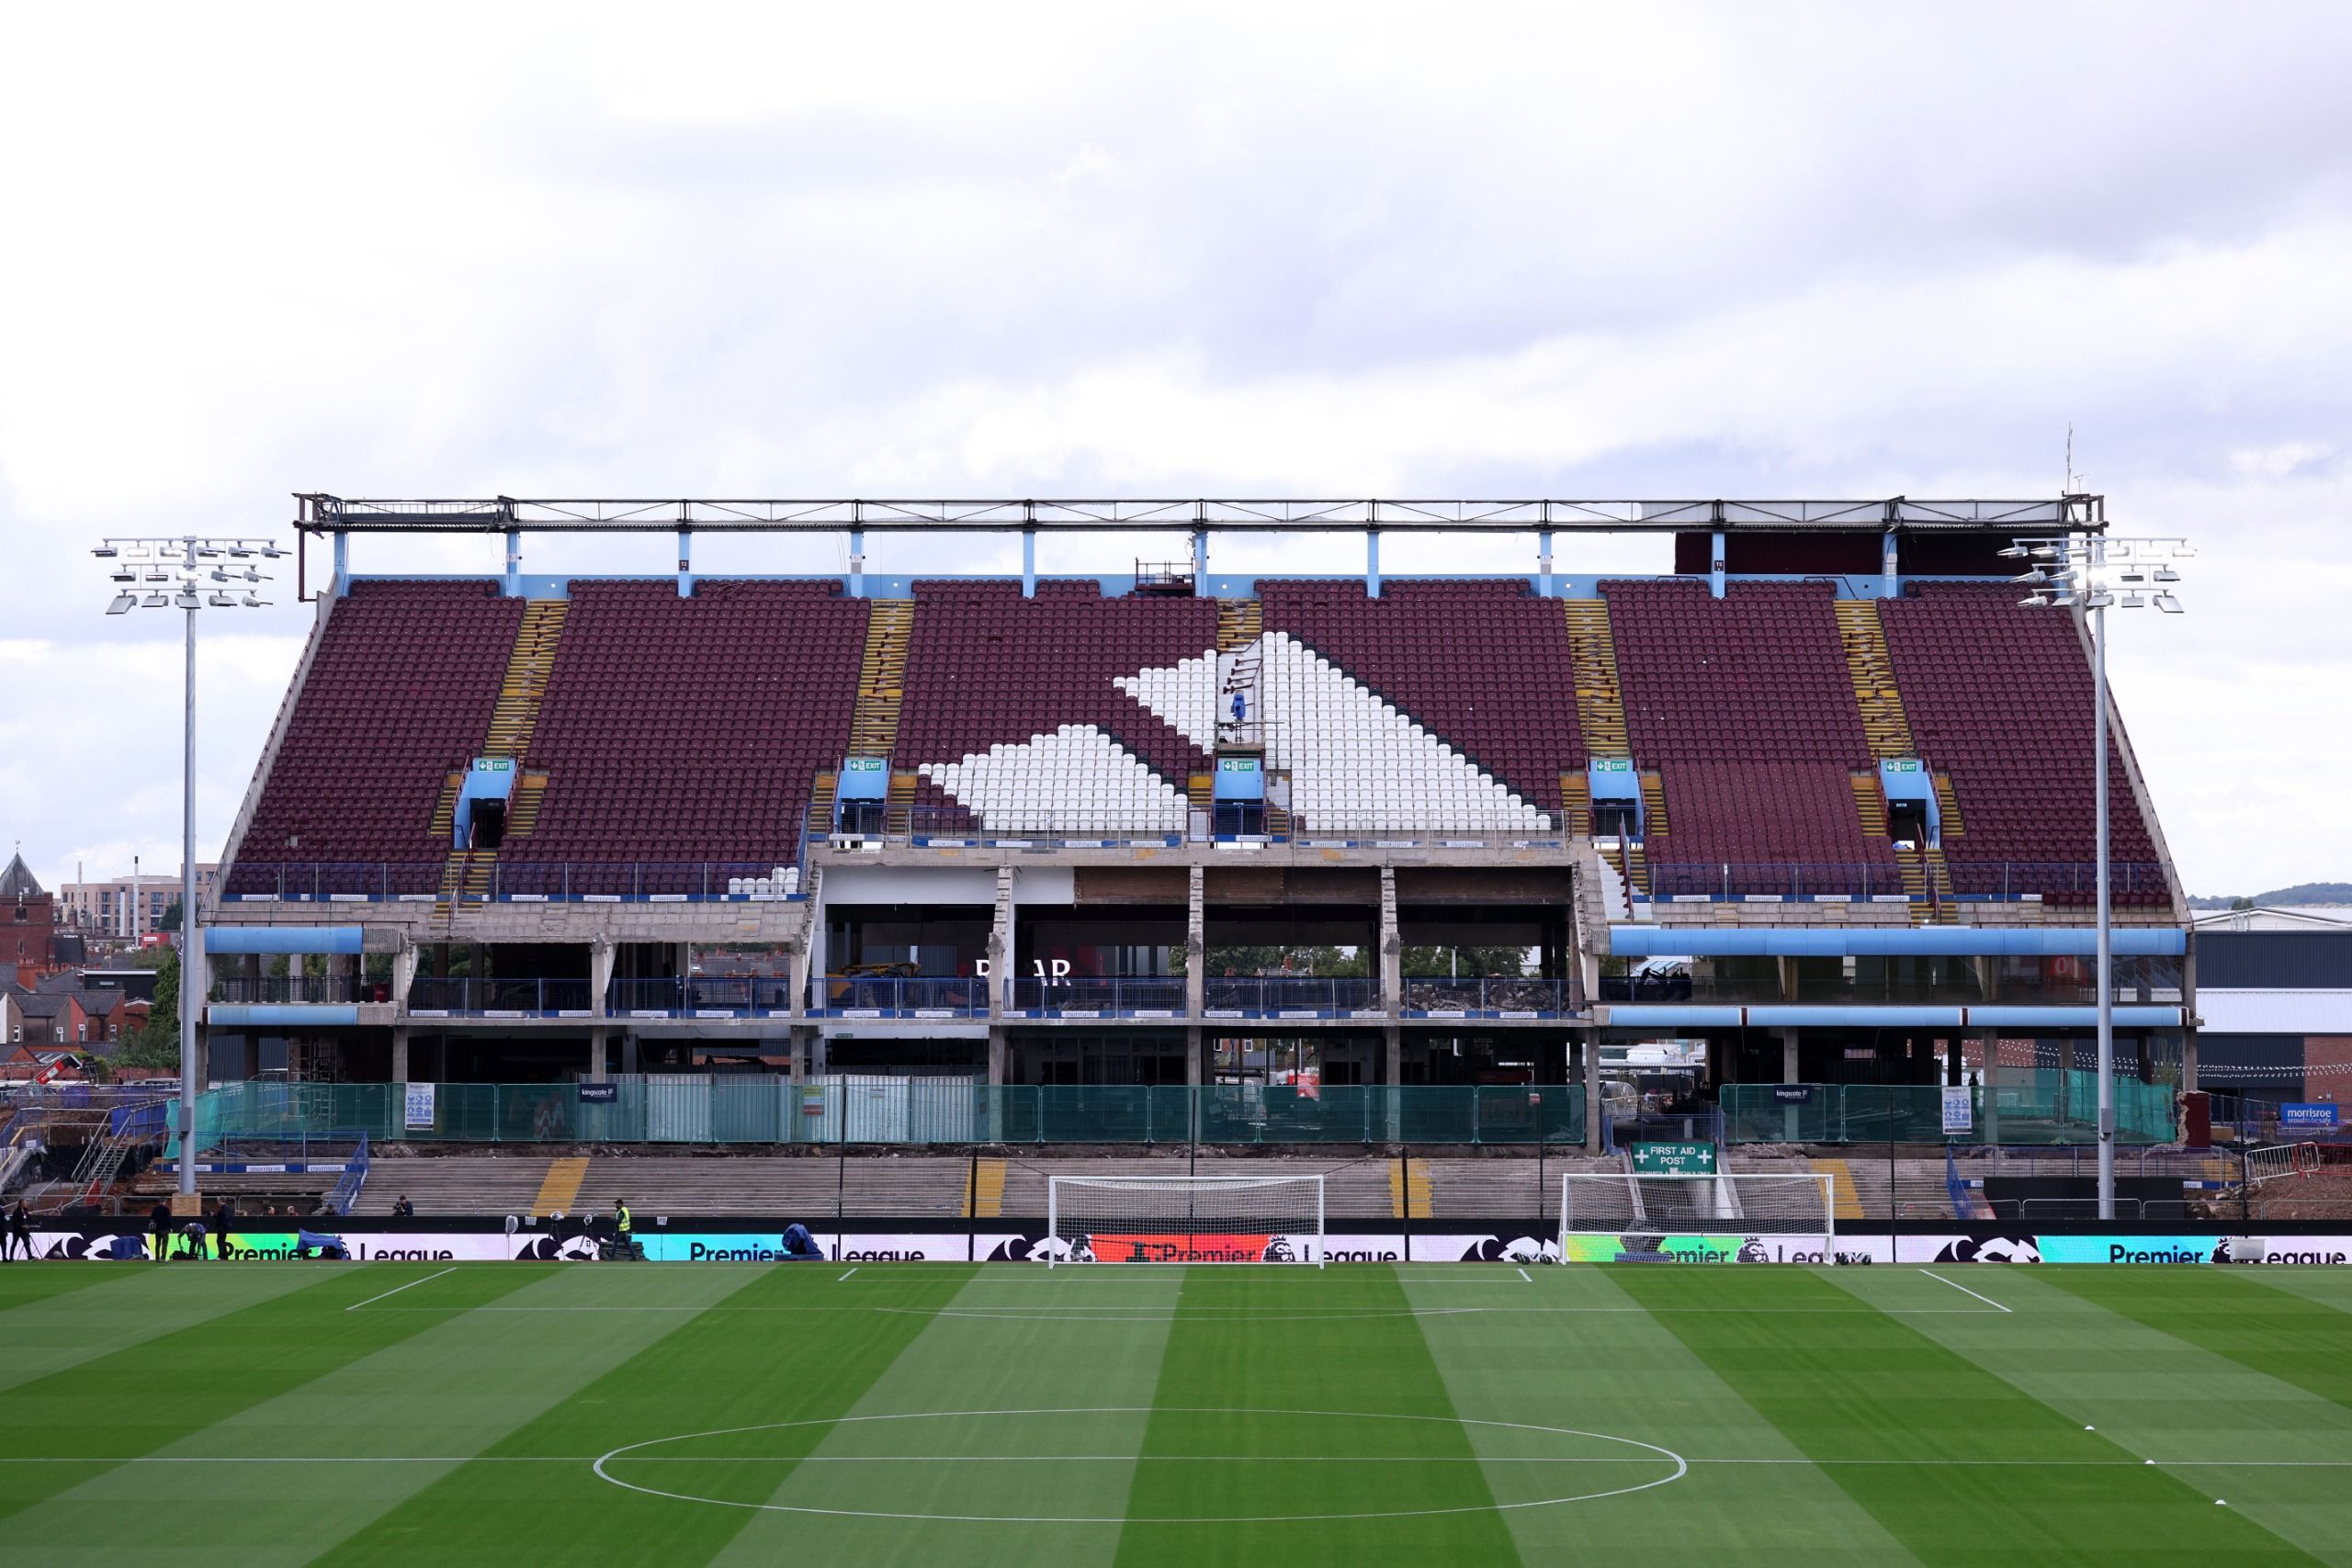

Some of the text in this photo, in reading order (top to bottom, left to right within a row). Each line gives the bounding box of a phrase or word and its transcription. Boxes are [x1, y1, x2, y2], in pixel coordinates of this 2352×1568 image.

[582, 1089, 607, 1097] kingscote
[1776, 1089, 1802, 1098] kingscote
[2287, 1108, 2332, 1118] morrisroe
[1650, 1146, 1696, 1155] FIRST AID
[360, 1243, 453, 1260] League
[832, 1244, 924, 1261] League
[1163, 1243, 1255, 1262] Premier
[1666, 1244, 1729, 1263] emier
[2109, 1244, 2346, 1264] Premier eague
